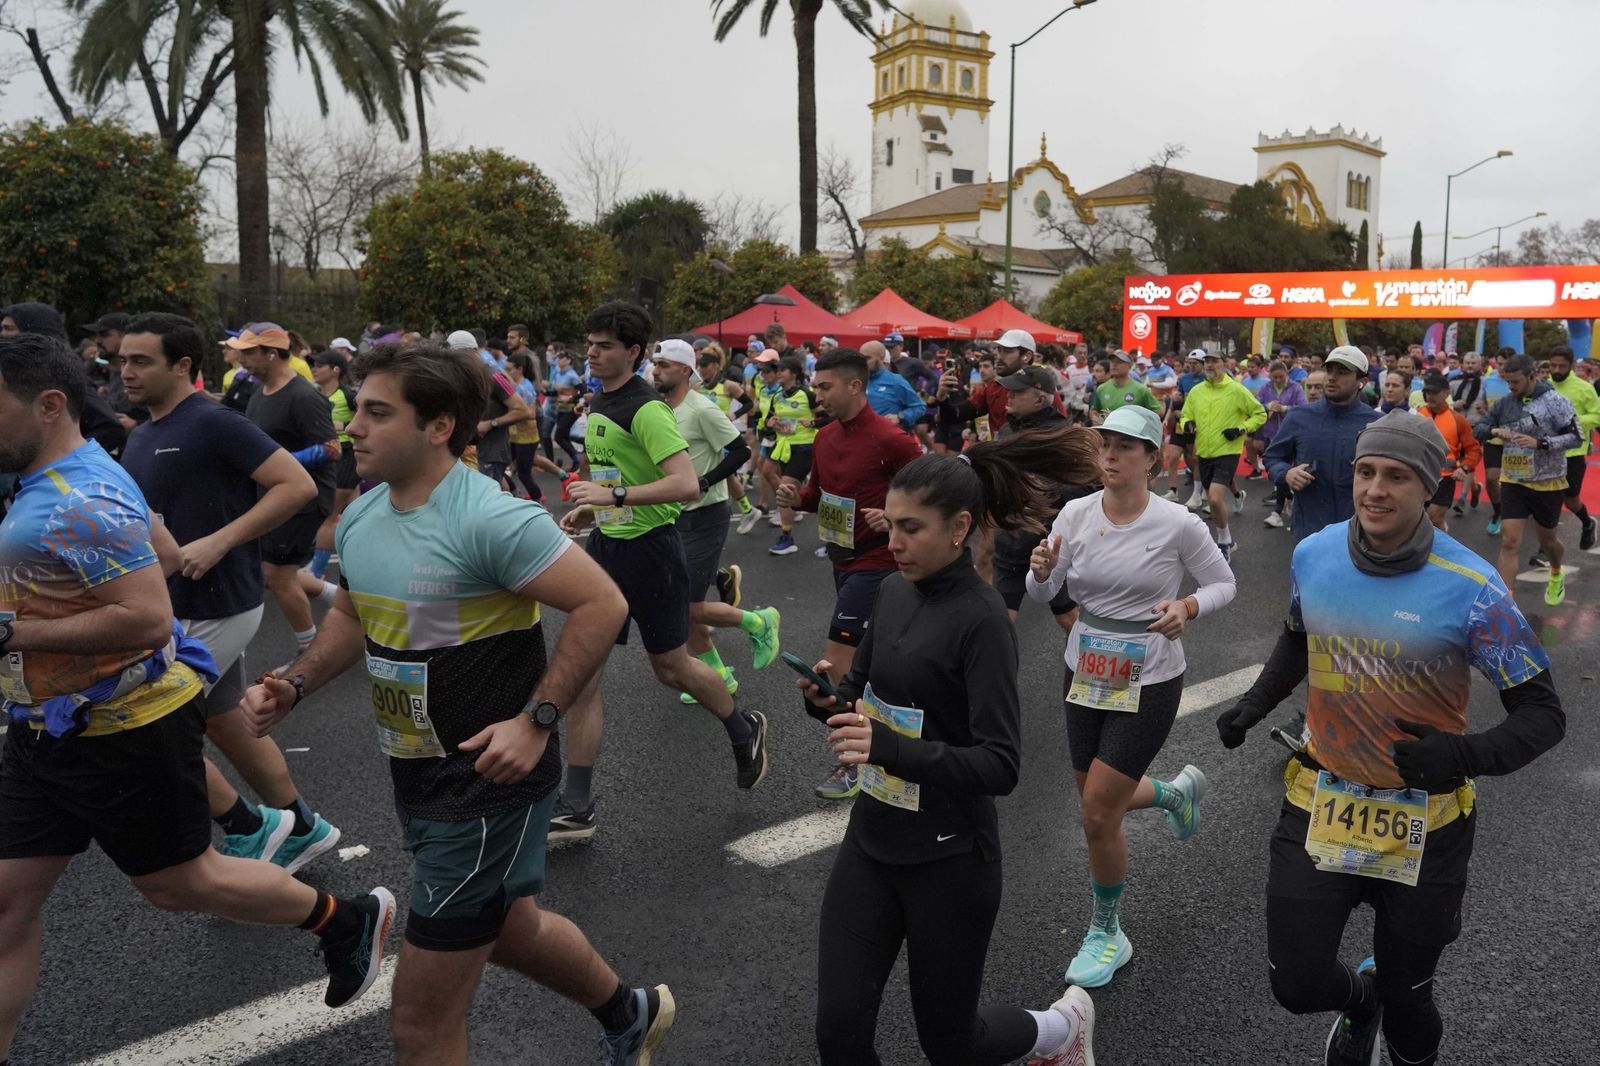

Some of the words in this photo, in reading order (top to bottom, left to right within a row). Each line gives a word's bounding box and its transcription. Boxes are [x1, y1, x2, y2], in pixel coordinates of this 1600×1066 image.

[1393, 278, 1468, 294] maratón
[1281, 287, 1325, 302] HOKA
[1411, 293, 1473, 306] sevilla
[1504, 455, 1528, 465] 16205
[408, 580, 457, 595] EVEREST
[1394, 610, 1420, 623] HOKA
[1081, 652, 1132, 680] 19814
[1324, 798, 1408, 840] 14156
